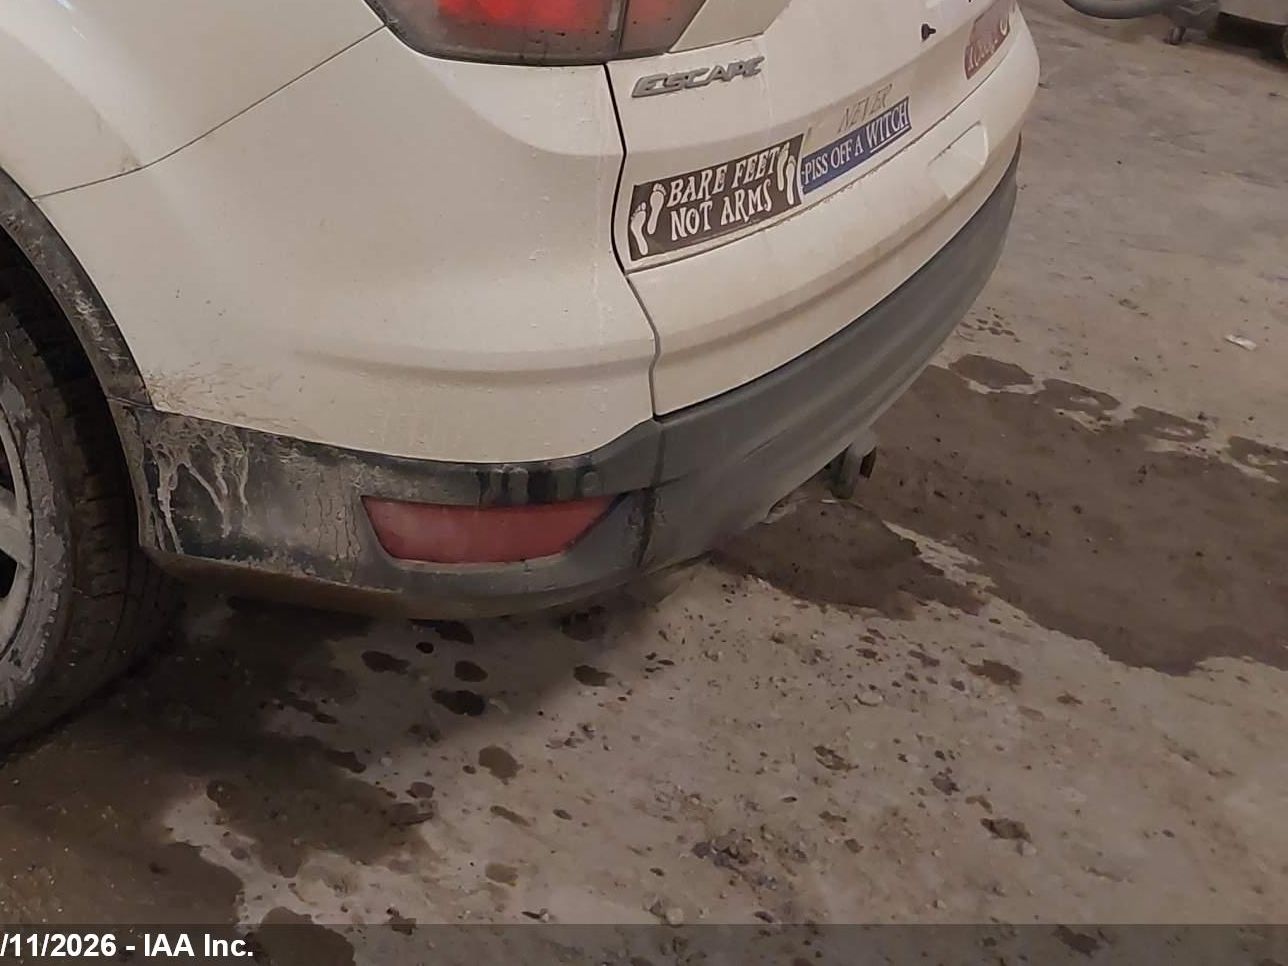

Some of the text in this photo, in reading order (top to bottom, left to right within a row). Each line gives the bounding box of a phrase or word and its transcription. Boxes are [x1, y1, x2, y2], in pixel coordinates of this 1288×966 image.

[631, 55, 765, 98] ESCAPE
[804, 100, 909, 185] PISS OFF A WITCH
[666, 146, 780, 208] BARE FEET
[670, 178, 773, 241] NOT ARMS
